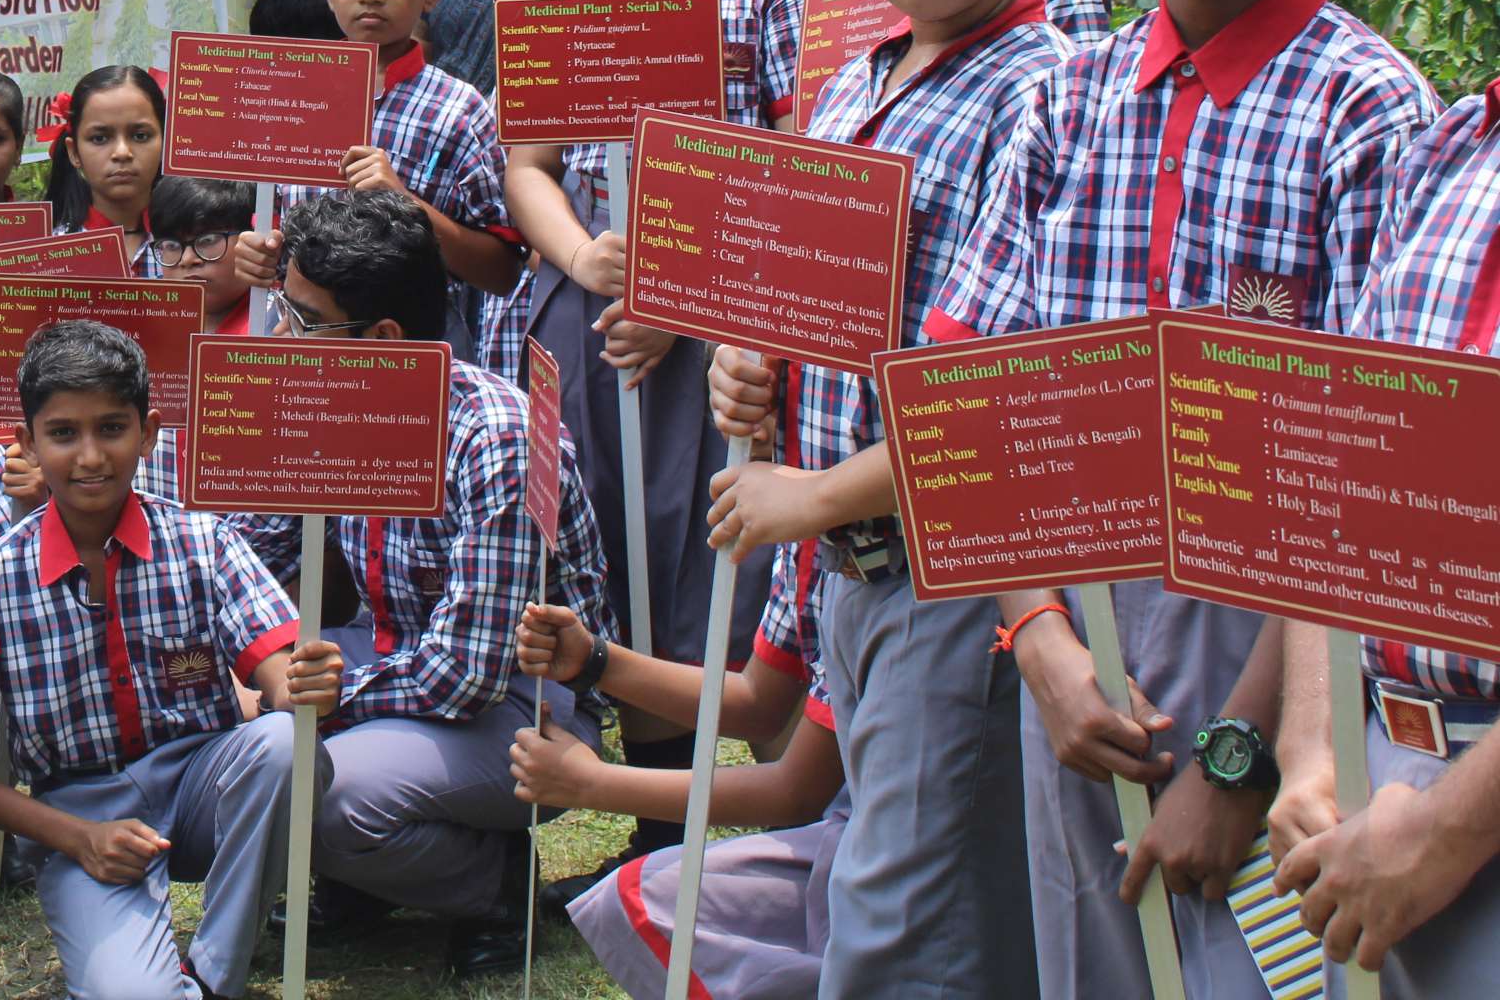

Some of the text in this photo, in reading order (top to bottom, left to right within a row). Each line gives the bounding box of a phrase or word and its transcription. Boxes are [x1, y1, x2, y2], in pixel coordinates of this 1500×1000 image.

[524, 0, 692, 16] Medicinal Plant Serial No. 3
[197, 45, 348, 64] Medicinal Plant Serial No. 12
[502, 41, 615, 53] Family Myrtaceae
[503, 72, 640, 87] English Name Common Guava
[673, 133, 869, 183] Medicinal Plant Serial No. 6
[645, 155, 889, 216] Scientific Name Andrographis paniculata (Burm.f.)
[15, 216, 26, 225] 23
[642, 193, 780, 233] Family Acanthaceae
[640, 231, 744, 264] English Name Creat
[1, 285, 178, 301] Medicinal Plant Serial No. 18
[226, 351, 416, 369] Medicinal Plant Serial No. 15
[921, 359, 1003, 386] Medicinal
[1007, 354, 1051, 374] Plant
[1071, 343, 1122, 365] Serial
[1201, 340, 1458, 397] Medicinal Plant Serial No. 7
[203, 373, 244, 383] Scientific
[246, 374, 272, 384] Name
[282, 376, 324, 388] Lawsonia
[326, 378, 359, 389] inermis
[203, 389, 330, 405] Family Lythraceae
[900, 399, 952, 417] Scientific
[955, 397, 988, 410] Name
[1005, 390, 1037, 406] Aegle
[1040, 383, 1096, 401] marmelos
[1169, 372, 1221, 395] Scientific
[1223, 380, 1258, 401] Name
[1271, 392, 1321, 414] Ocimum
[1324, 403, 1396, 426] tenuiflorum
[905, 414, 1061, 441] Family Rutaceae
[1170, 397, 1223, 422] Synonym
[1272, 417, 1322, 439] Ocimum
[1326, 431, 1377, 448] sanctum
[1171, 422, 1338, 467] Family Lamiaceae
[914, 459, 1074, 489] English Name Bael Tree
